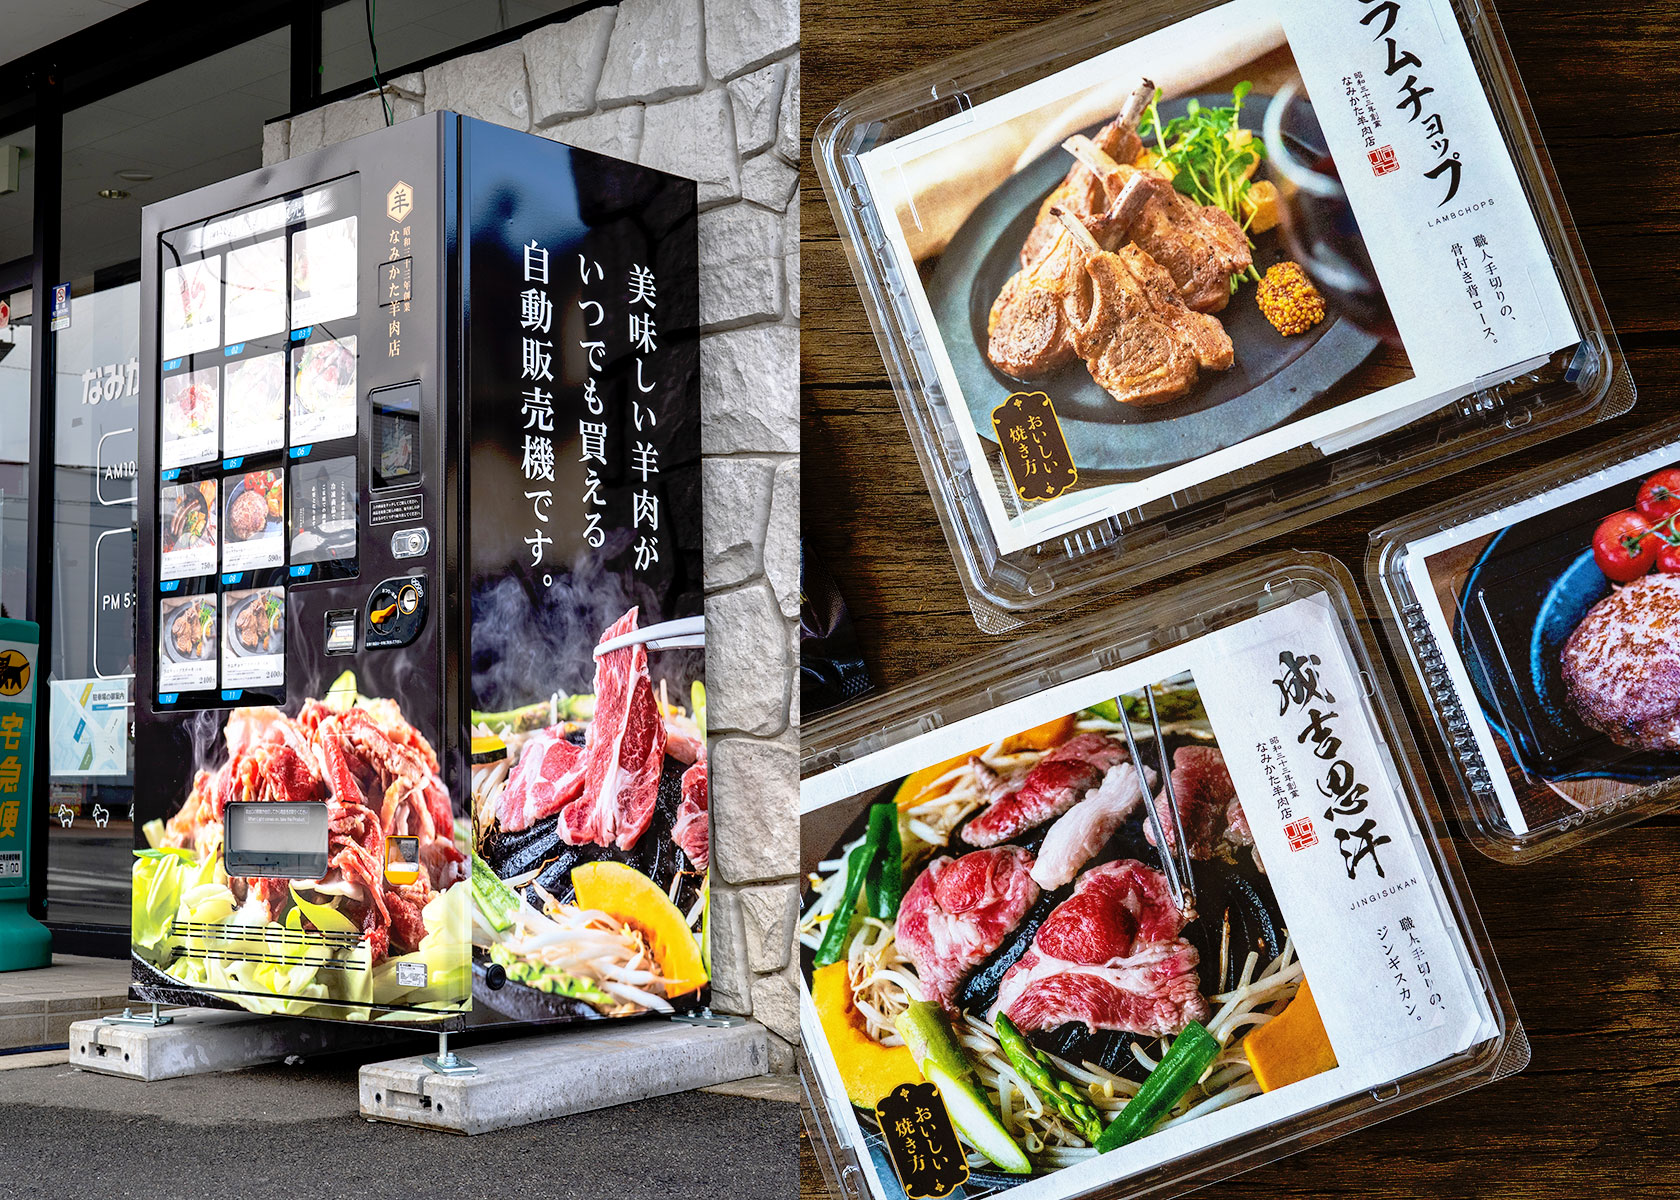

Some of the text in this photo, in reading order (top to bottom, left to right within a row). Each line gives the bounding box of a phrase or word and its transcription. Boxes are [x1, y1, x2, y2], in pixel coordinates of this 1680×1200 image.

[1341, 76, 1376, 148] なみかた羊肉店
[1359, 0, 1463, 209] ラムチョップ
[390, 188, 410, 213] 羊
[1427, 198, 1495, 228] LAMBCHOPS
[388, 229, 401, 358] なみかた羊肉店
[1450, 242, 1499, 344] 骨付き背ロース。
[1472, 233, 1516, 321] 職人手切りの、
[519, 239, 556, 588] 自動販売機です。
[577, 252, 608, 549] いつでも買える
[628, 263, 660, 571] 美味しい羊肉が
[1027, 415, 1058, 474] おいしい
[1009, 425, 1037, 478] 焼き方
[103, 595, 120, 611] PM
[0, 712, 24, 840] 宅急便
[1256, 742, 1293, 821] なみかた羊肉店
[1272, 650, 1392, 880] 成吉思汗
[1350, 877, 1418, 911] JINGISUKAN
[1376, 925, 1422, 1022] ジンギスカン。
[1399, 915, 1446, 1011] 職人手切りの、
[895, 1117, 926, 1175] 焼き方
[914, 1106, 949, 1171] おいしい
